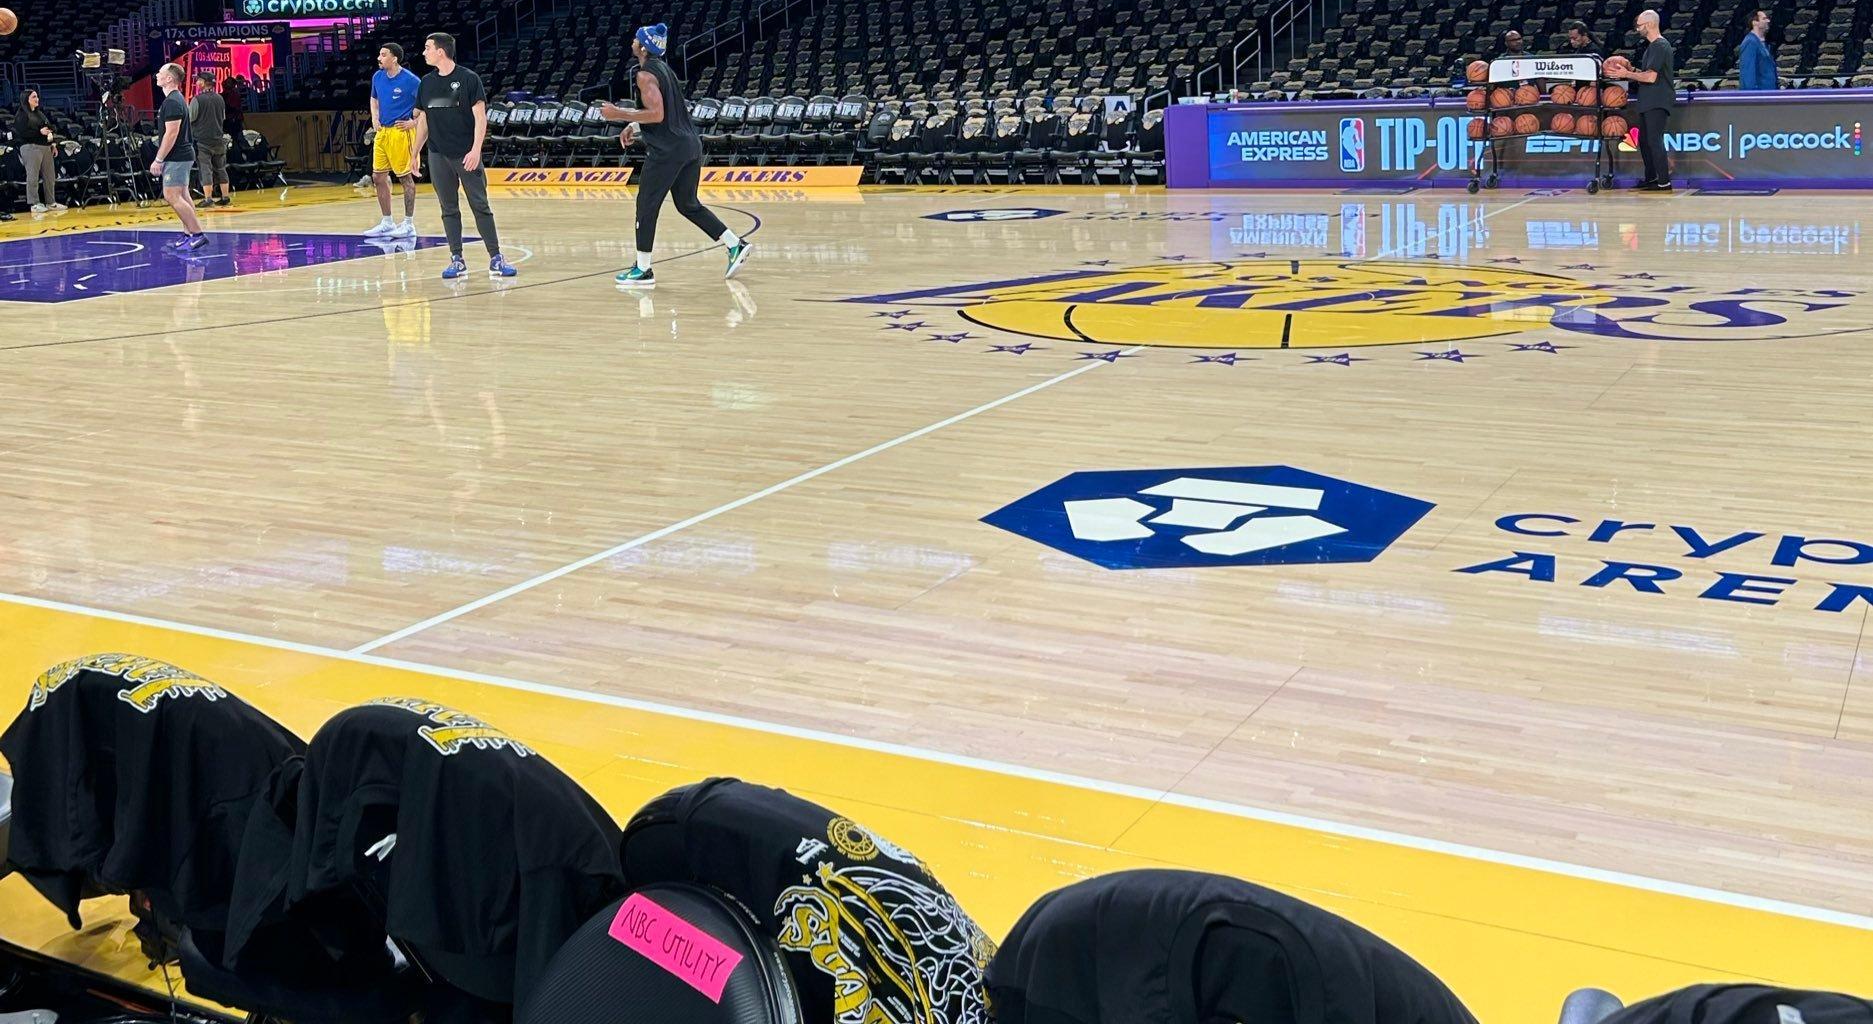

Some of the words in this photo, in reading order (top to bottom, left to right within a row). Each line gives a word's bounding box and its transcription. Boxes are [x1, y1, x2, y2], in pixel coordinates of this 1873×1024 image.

[164, 28, 185, 39] 17x
[188, 25, 269, 38] CHAMPIONS
[1534, 61, 1574, 71] Wilson
[1227, 130, 1326, 146] AMERICAN
[1664, 132, 1722, 152] NBC
[1739, 125, 1851, 159] peacock
[1241, 147, 1329, 162] EXPRESS
[504, 171, 551, 182] LOS
[703, 170, 807, 183] LAKERS
[1355, 277, 1866, 298] ANGELES
[836, 269, 1873, 342] LAKERS
[1494, 513, 1873, 567] cryp
[621, 894, 657, 946] NBC
[663, 928, 727, 983] UTILITY
